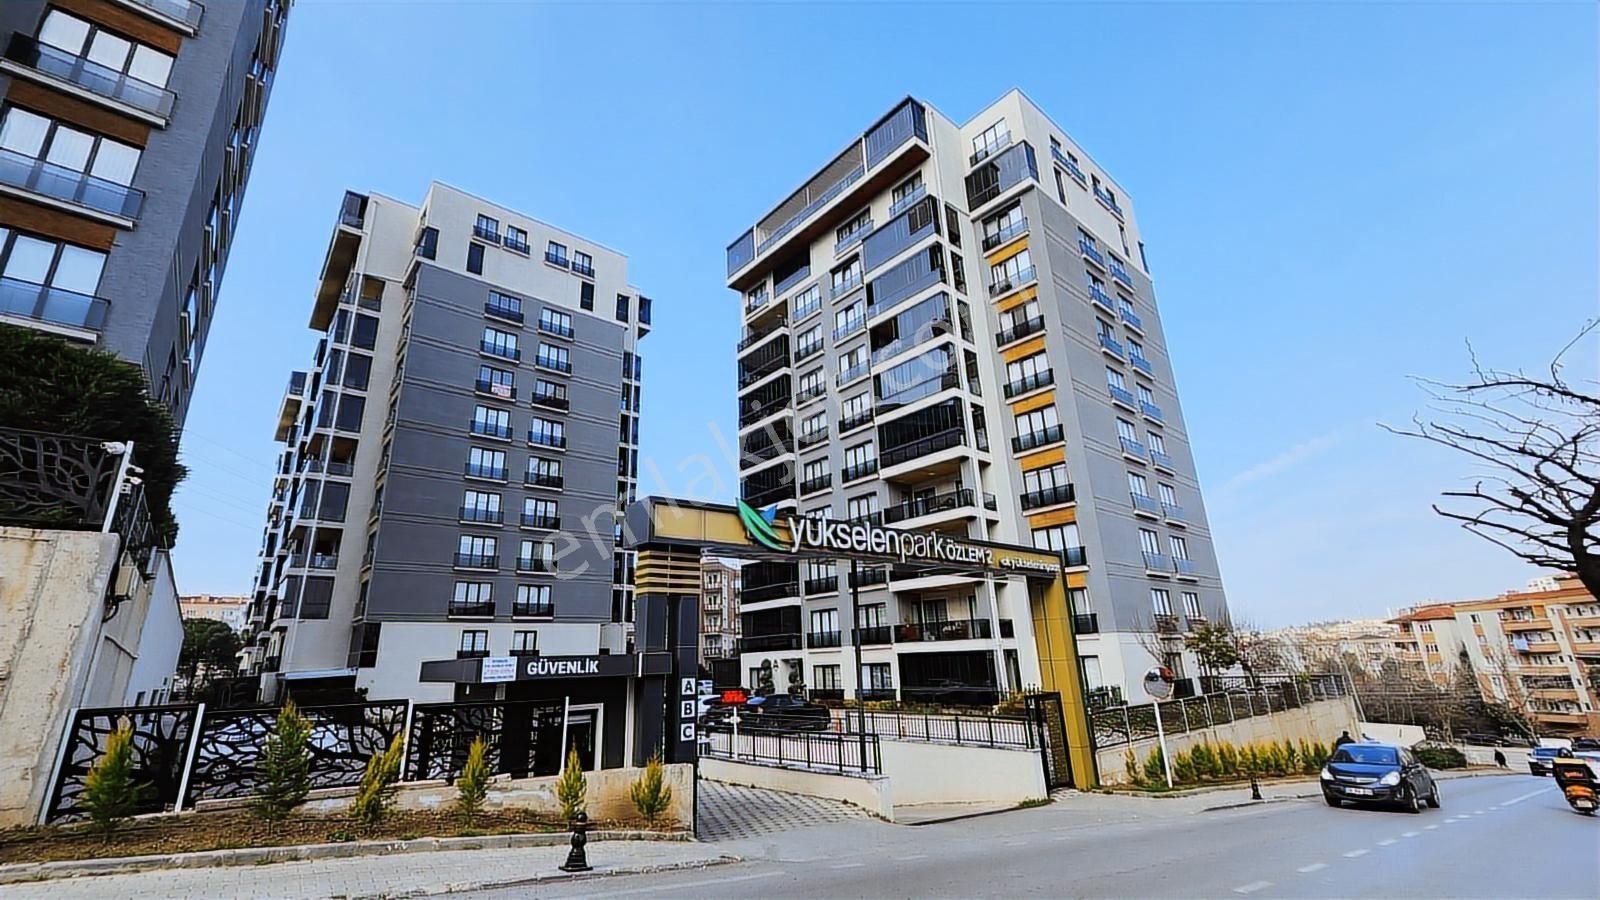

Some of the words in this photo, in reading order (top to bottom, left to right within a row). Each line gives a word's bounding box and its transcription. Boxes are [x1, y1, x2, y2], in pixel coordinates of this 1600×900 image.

[946, 540, 985, 564] ÖZLEM
[986, 549, 994, 564] 2
[527, 658, 599, 675] GÜVENLİK
[684, 680, 693, 693] A
[684, 703, 692, 715] B
[683, 726, 692, 738] C
